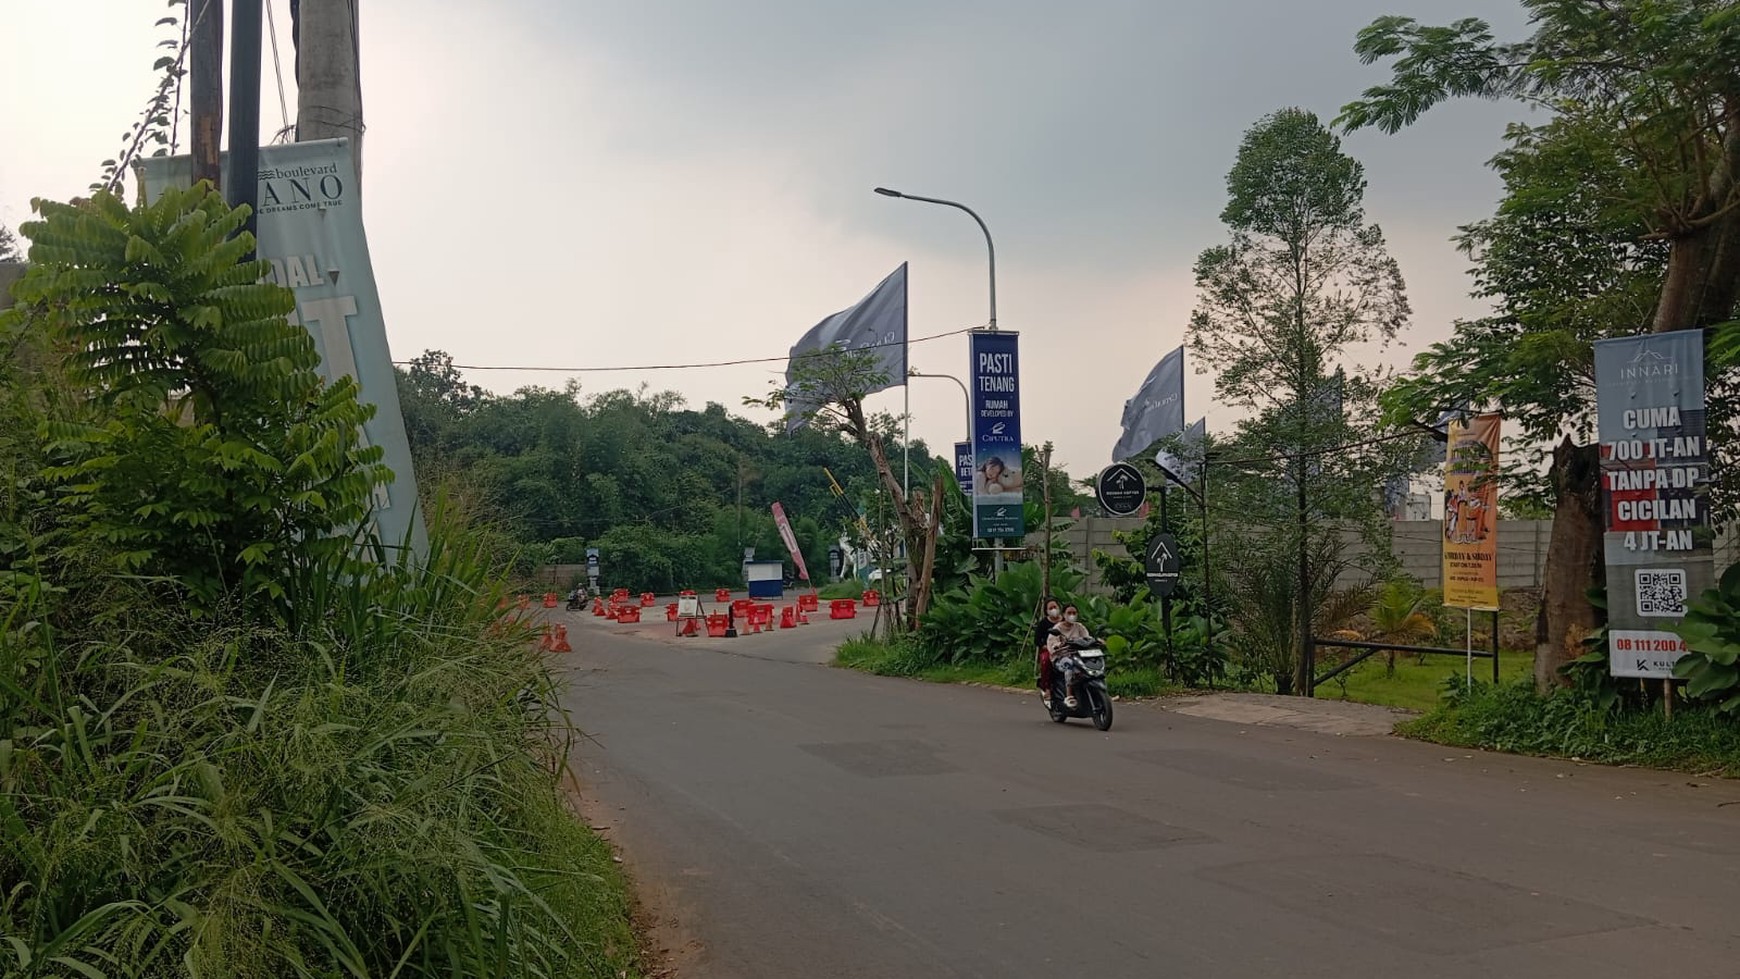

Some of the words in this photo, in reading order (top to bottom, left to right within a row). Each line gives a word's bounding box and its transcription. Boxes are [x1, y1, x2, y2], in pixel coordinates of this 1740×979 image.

[274, 161, 338, 179] boulevard
[262, 174, 343, 207] ANO
[266, 203, 298, 213] DREAMS
[262, 254, 324, 288] DAL
[979, 352, 1012, 374] PASTI
[1620, 363, 1678, 380] INNARI
[978, 376, 1015, 392] TENANG
[985, 400, 1008, 409] RUMAH
[1623, 406, 1682, 429] CUMA
[982, 434, 1014, 442] CIPUTRA
[1607, 440, 1643, 461] 700
[1647, 436, 1700, 459] JT-AN
[959, 454, 973, 467] PAS
[1607, 469, 1669, 491] TANPA
[1672, 467, 1699, 488] DP
[1617, 499, 1696, 521] CICILAN
[1624, 531, 1637, 551] 4
[1640, 530, 1693, 550] JT-AN
[1617, 639, 1632, 650] 08
[1634, 639, 1651, 651] 111
[1653, 640, 1676, 651] 200
[1679, 639, 1687, 652] 4
